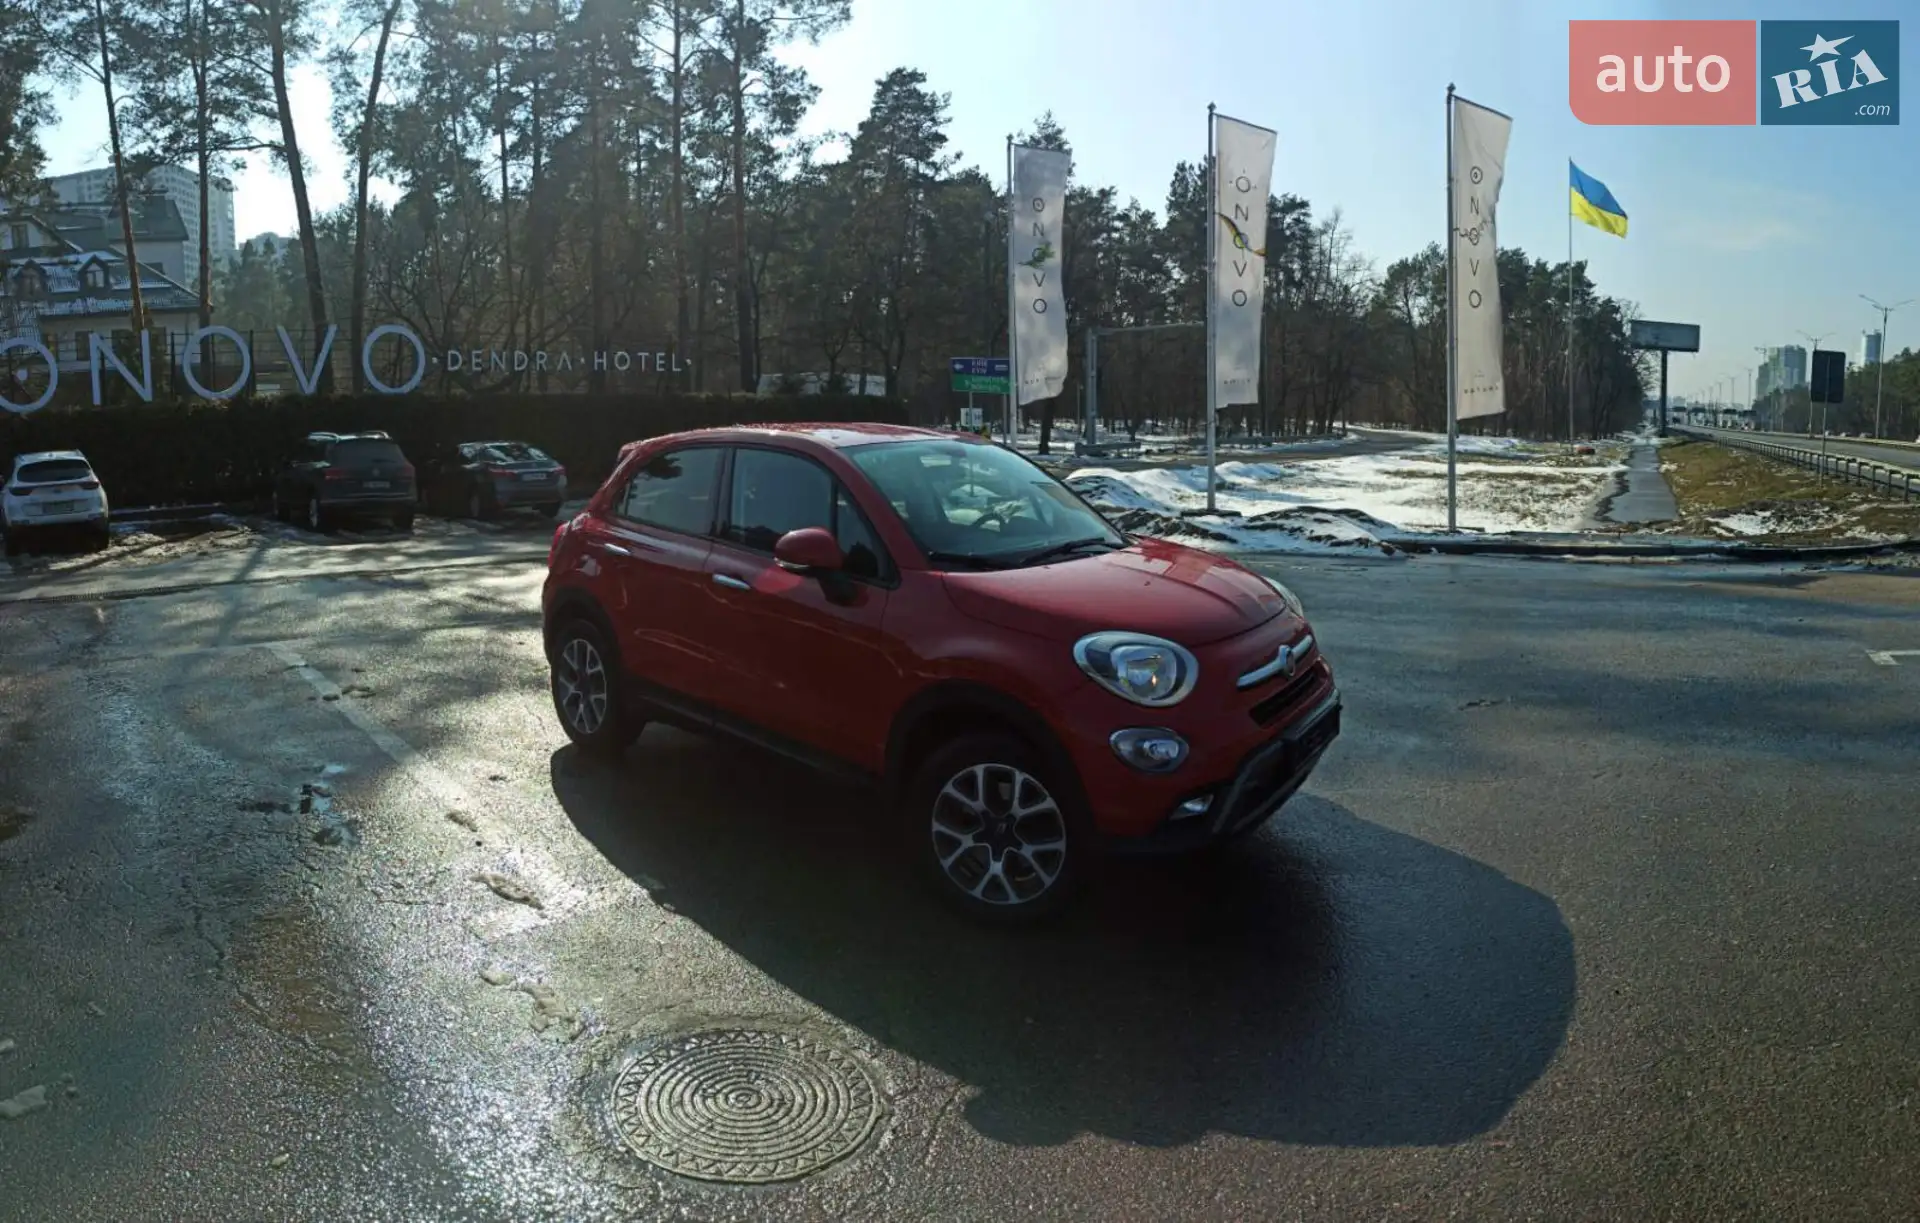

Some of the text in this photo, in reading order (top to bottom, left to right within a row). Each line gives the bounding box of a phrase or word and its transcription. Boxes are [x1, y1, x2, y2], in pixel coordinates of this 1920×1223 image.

[1031, 196, 1048, 314] ONOVO
[1231, 175, 1251, 307] ONOVO
[1467, 165, 1484, 309] ONOVO
[0, 324, 426, 414] ONOVO
[447, 350, 682, 372] DENDRA HOTEL
